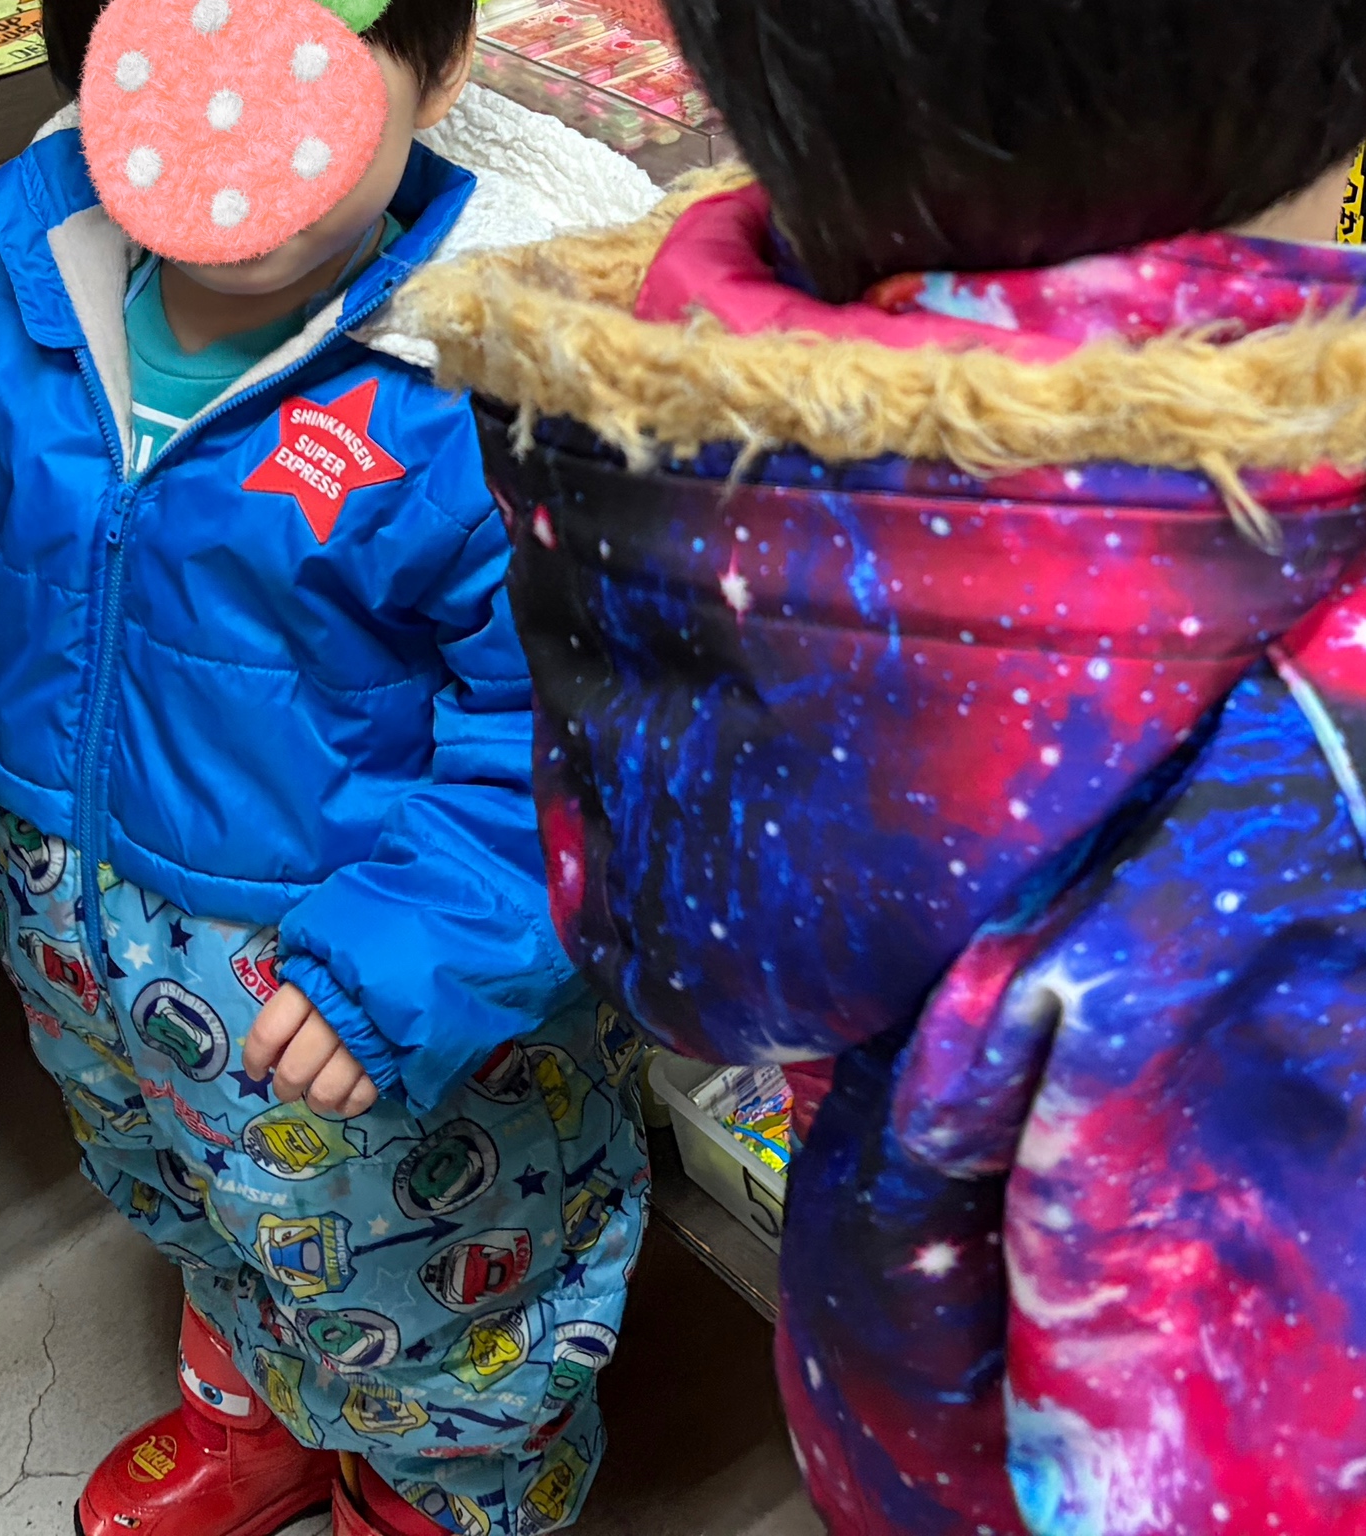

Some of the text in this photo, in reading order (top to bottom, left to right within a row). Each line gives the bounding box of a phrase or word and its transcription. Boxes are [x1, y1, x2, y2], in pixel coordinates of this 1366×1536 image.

[289, 408, 377, 472] SHINKANSEN
[294, 433, 347, 479] SUPER
[274, 446, 343, 501] EXPRESS
